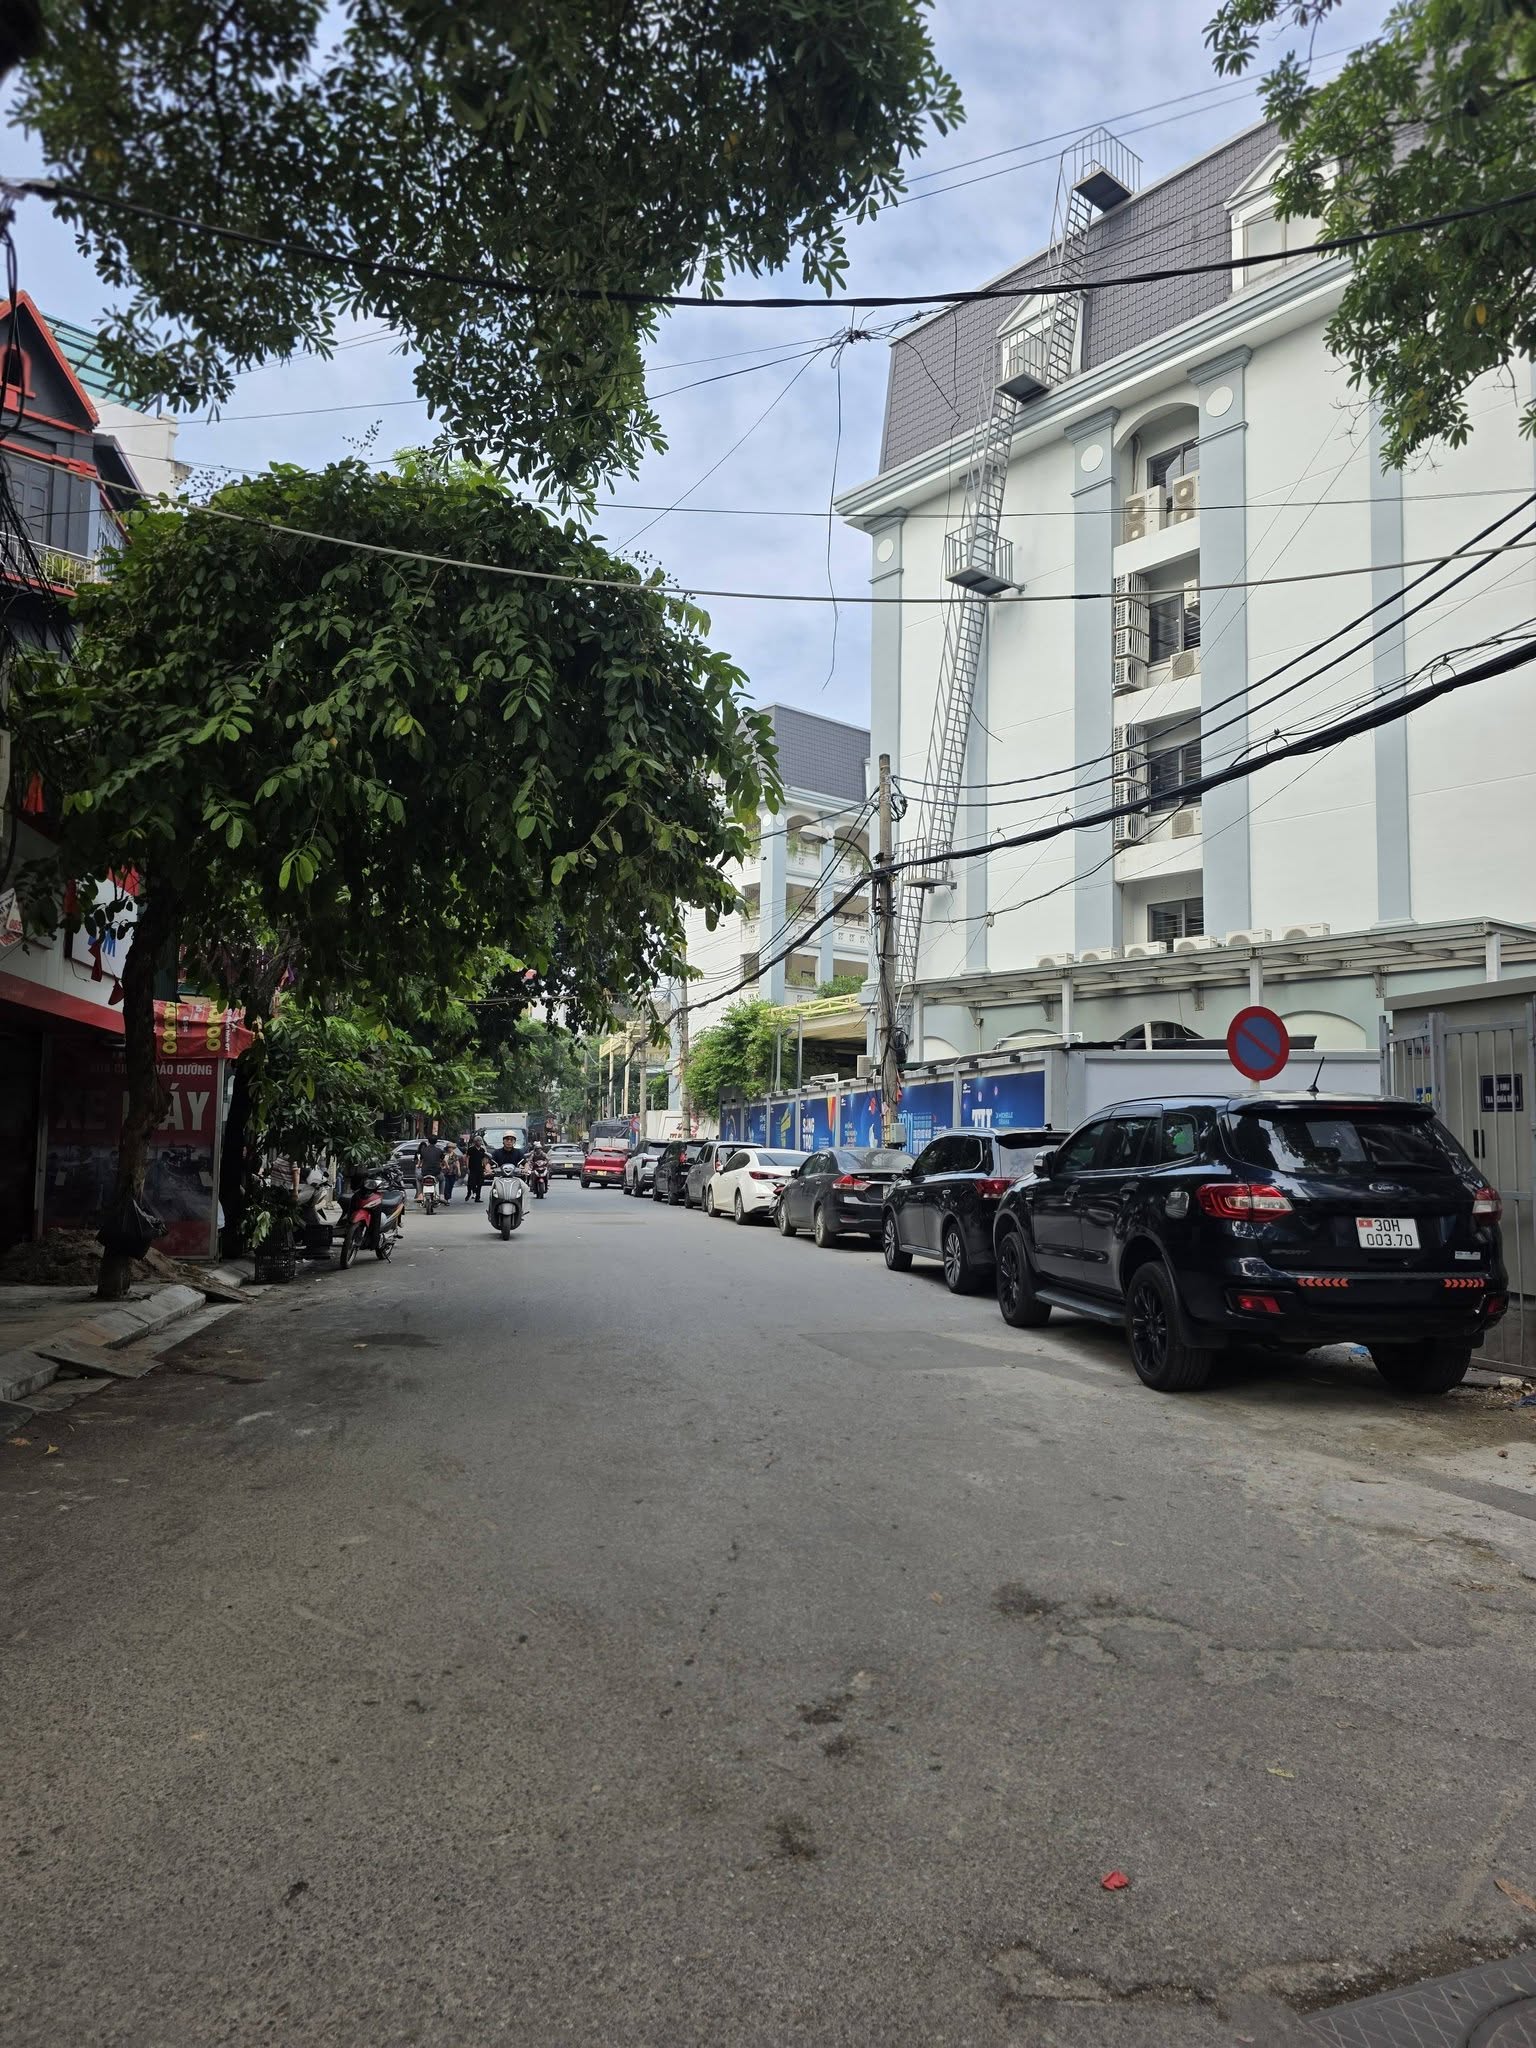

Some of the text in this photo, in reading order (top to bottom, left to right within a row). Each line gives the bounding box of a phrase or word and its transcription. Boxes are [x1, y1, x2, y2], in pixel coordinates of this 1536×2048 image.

[176, 1061, 213, 1076] DƯỠNG
[1374, 1219, 1400, 1232] 30H
[1366, 1233, 1413, 1247] 003.70
